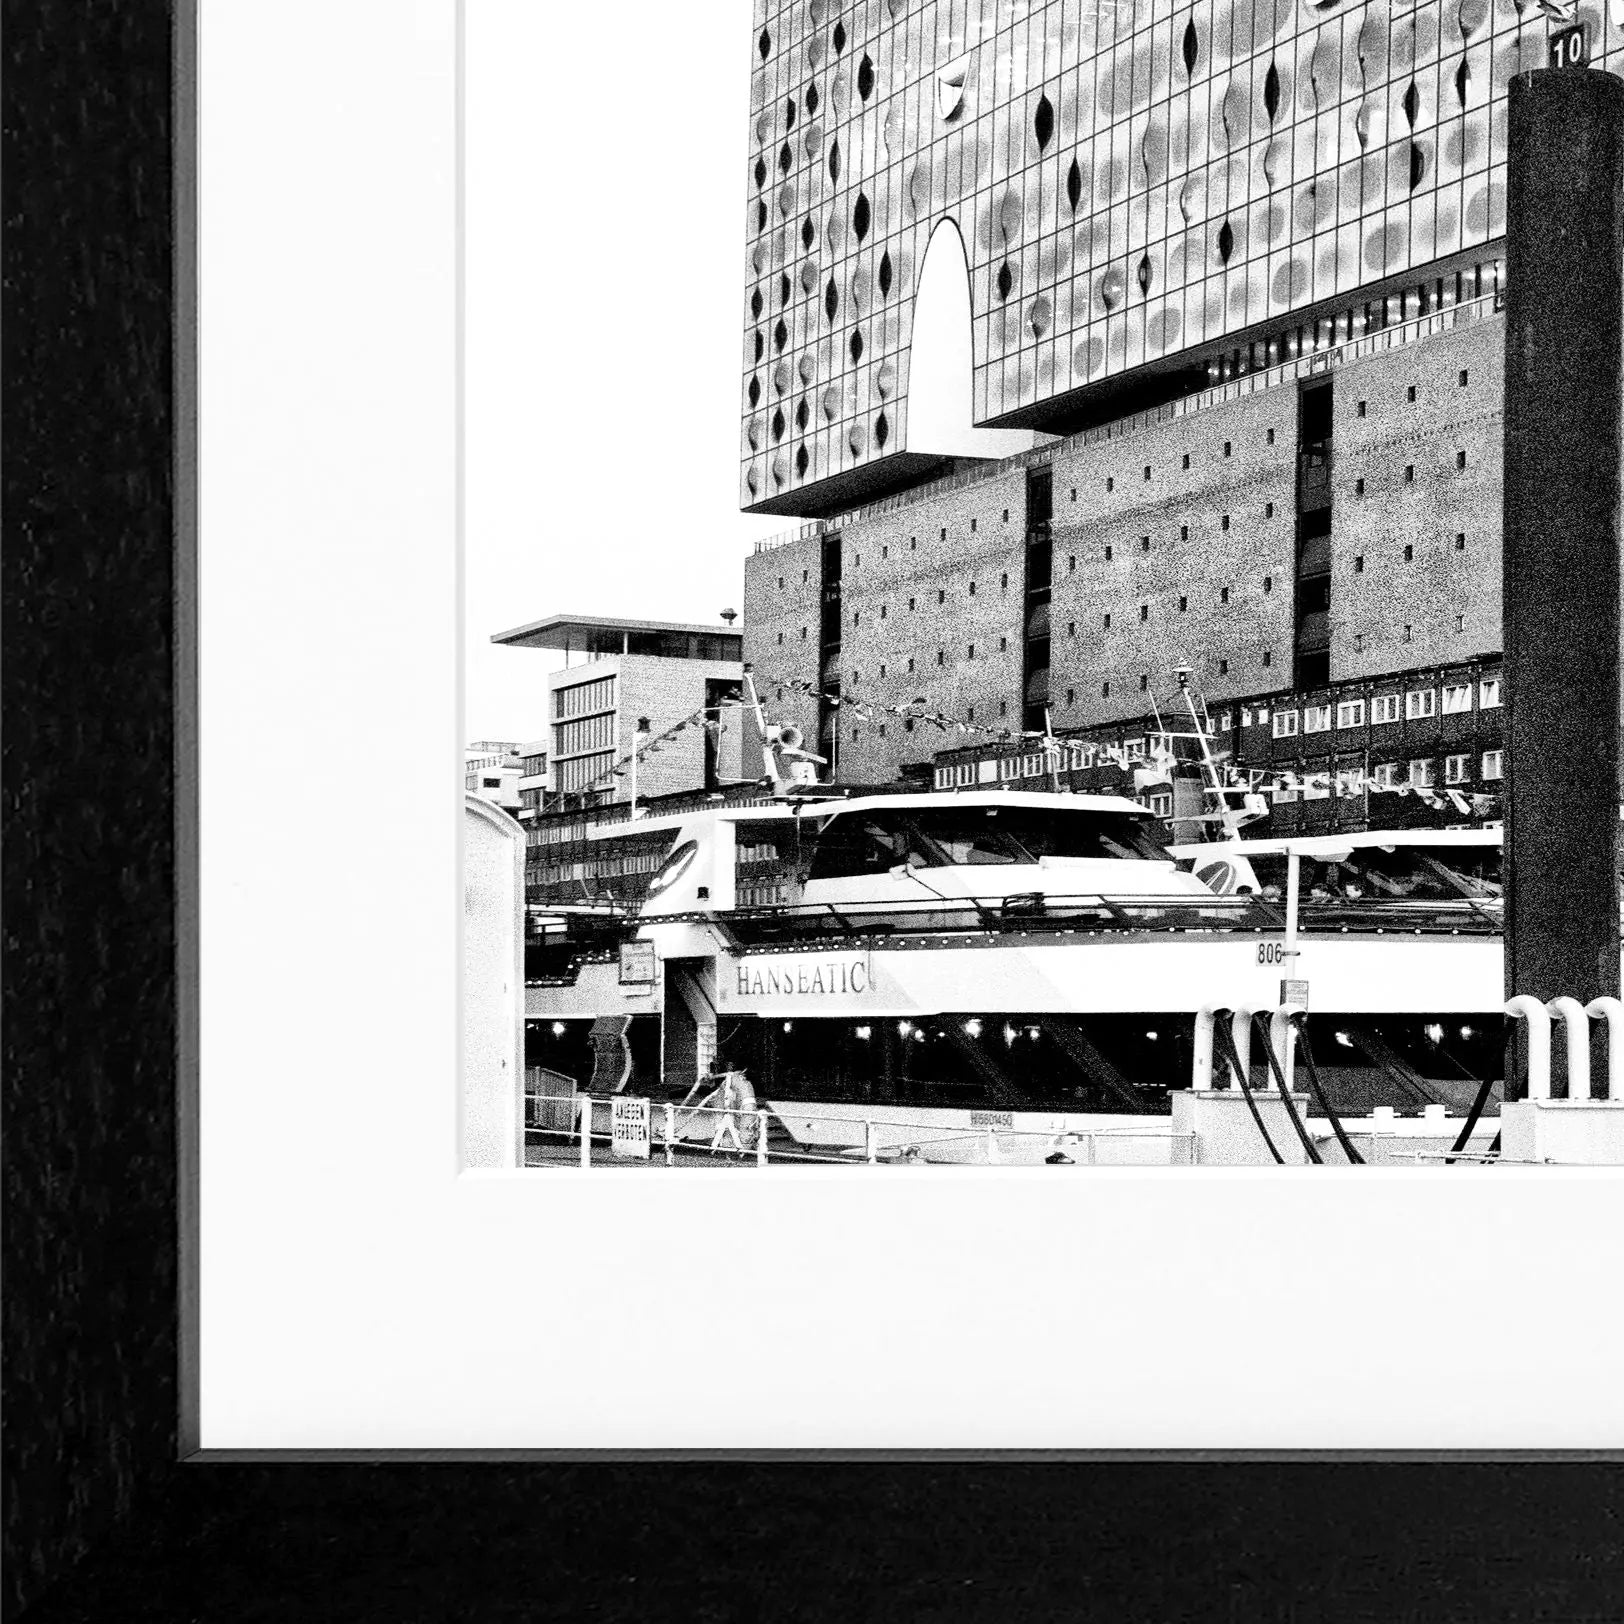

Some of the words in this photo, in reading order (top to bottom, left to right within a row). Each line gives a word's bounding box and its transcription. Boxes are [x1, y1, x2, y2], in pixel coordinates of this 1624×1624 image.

[1554, 32, 1582, 68] 10
[1258, 943, 1282, 963] 806
[737, 961, 866, 995] HANSEATIC
